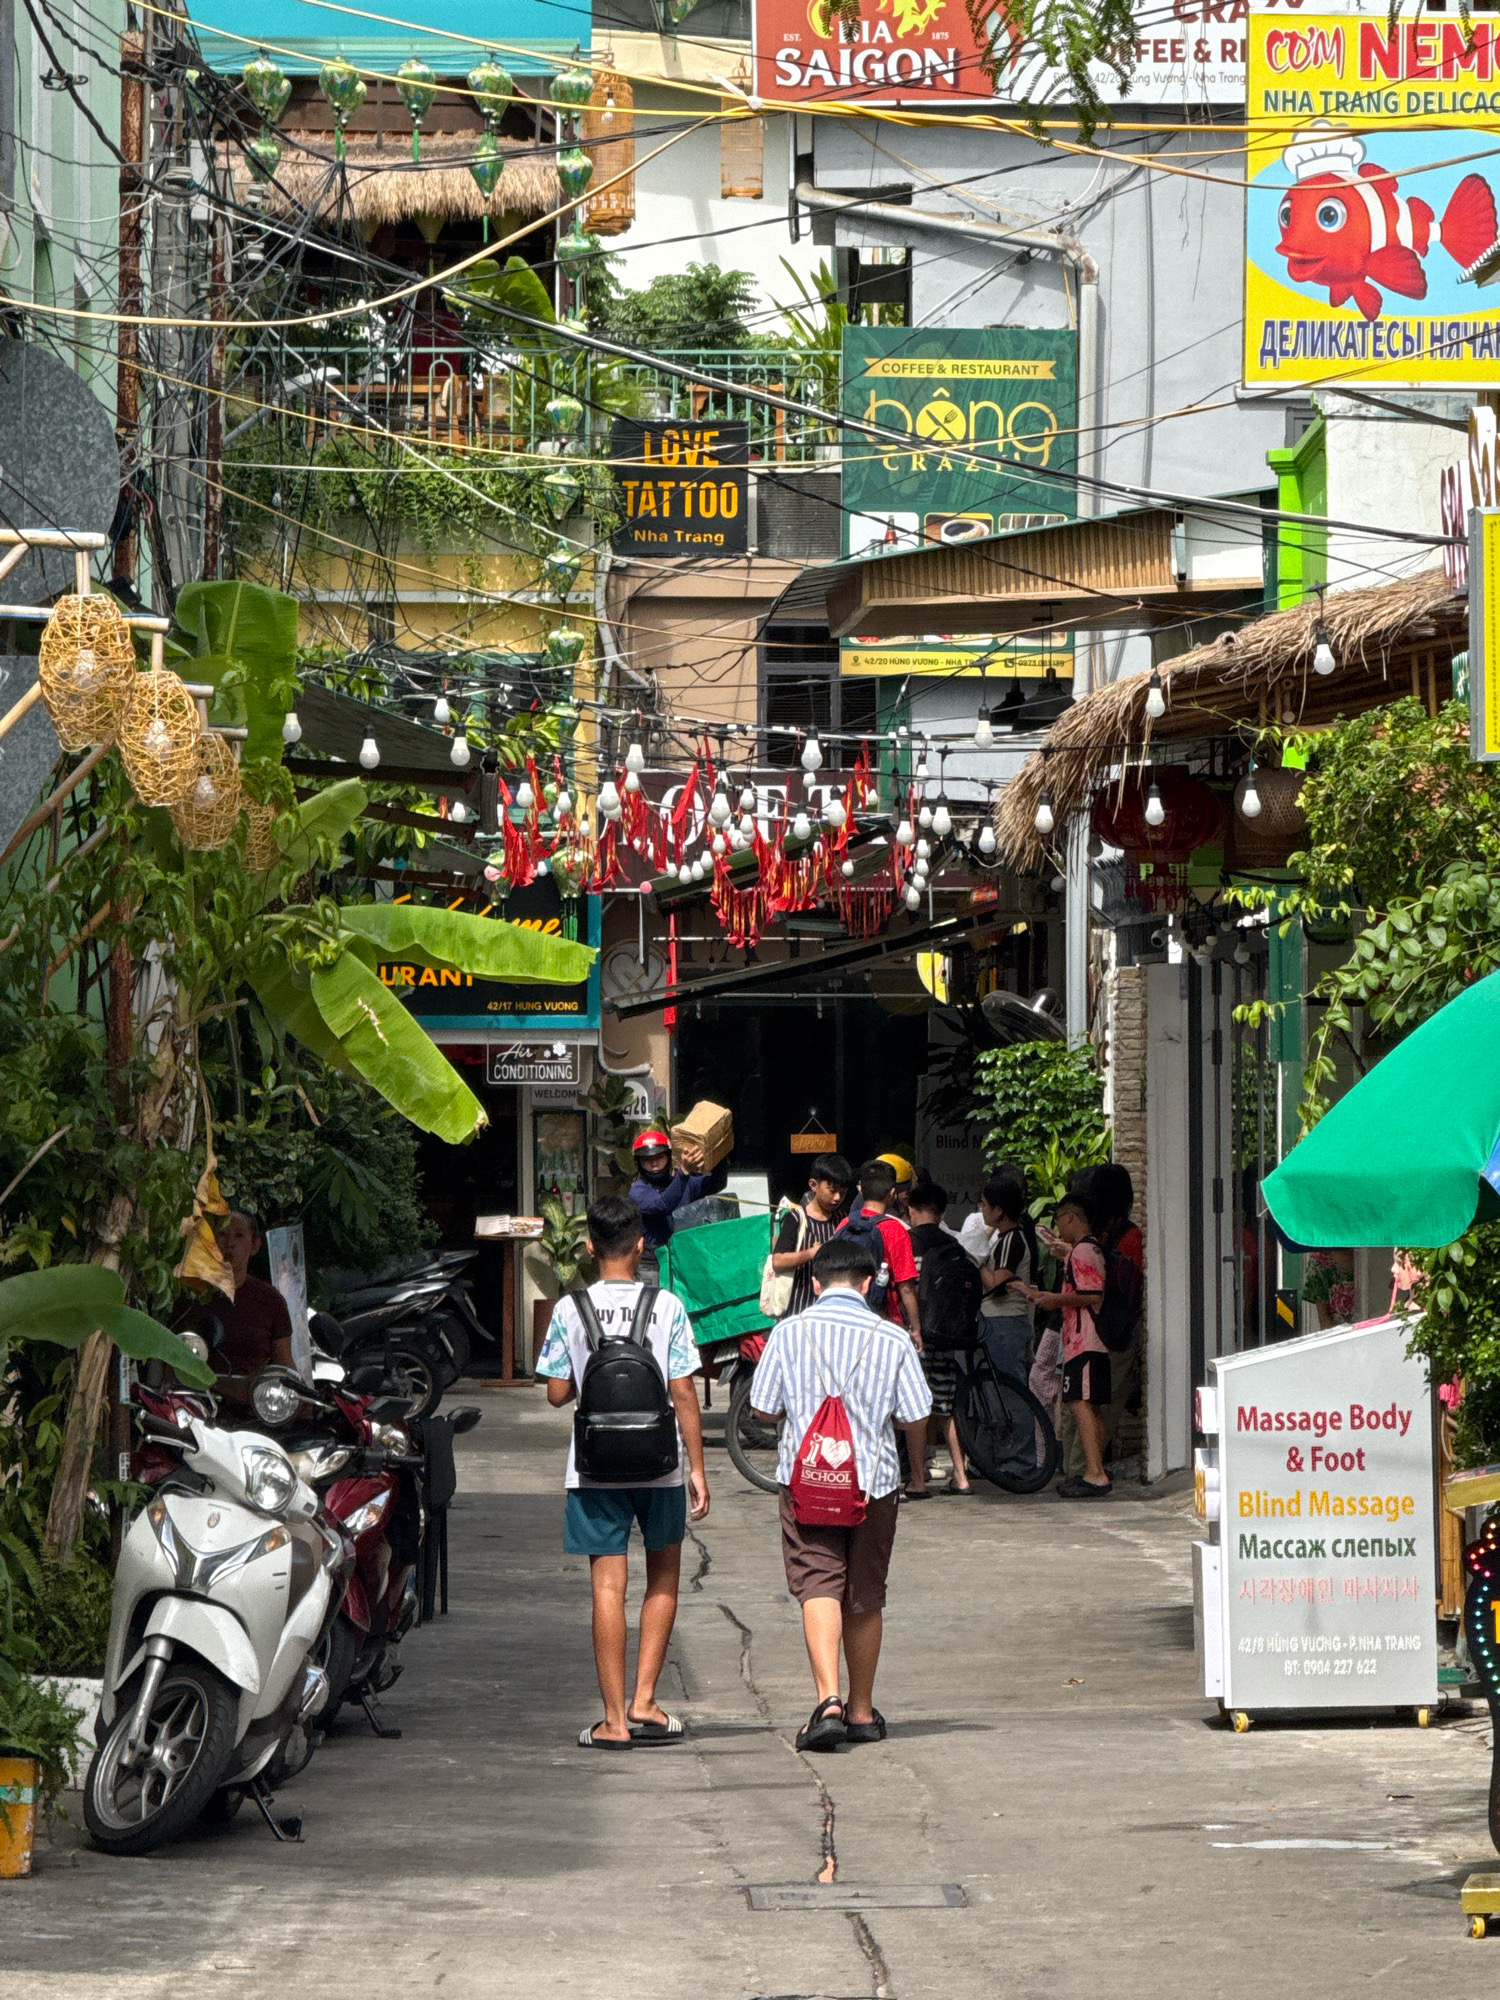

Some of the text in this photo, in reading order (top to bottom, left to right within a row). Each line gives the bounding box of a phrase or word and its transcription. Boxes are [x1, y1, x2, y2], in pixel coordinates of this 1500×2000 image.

[783, 33, 801, 42] EST.
[931, 32, 949, 40] 1875
[1193, 38, 1210, 63] &
[1359, 22, 1500, 80] NEM
[775, 47, 956, 86] SAIGON
[1264, 91, 1313, 112] NHA
[1320, 91, 1399, 113] TRANG
[1260, 320, 1422, 368] ДЕЛИКАТЕСЫ
[881, 363, 1039, 376] COFFEE & RESTAURANT
[643, 428, 720, 468] LOVE
[621, 480, 739, 519] TATTOO
[633, 529, 725, 546] Nha Trang
[864, 658, 888, 666] 42/20
[946, 659, 963, 667] NHA
[380, 965, 473, 986] URANT
[487, 1002, 579, 1011] 42/17 HUNG VUONG
[497, 1042, 533, 1062] Air
[494, 1064, 573, 1080] CONDITIONING
[623, 1095, 647, 1117] /28
[596, 1308, 615, 1325] uy
[1237, 1403, 1412, 1438] Massage Body
[1287, 1446, 1366, 1472] & Foot
[1239, 1490, 1415, 1523] Blind Massage
[1239, 1533, 1416, 1560] Массаж слепых
[1239, 1575, 1419, 1605] 시각장애인 마사지사
[1384, 1634, 1422, 1651] TRANG
[1303, 1659, 1331, 1675] 0904
[1333, 1659, 1353, 1675] 227
[1356, 1658, 1377, 1675] 622
